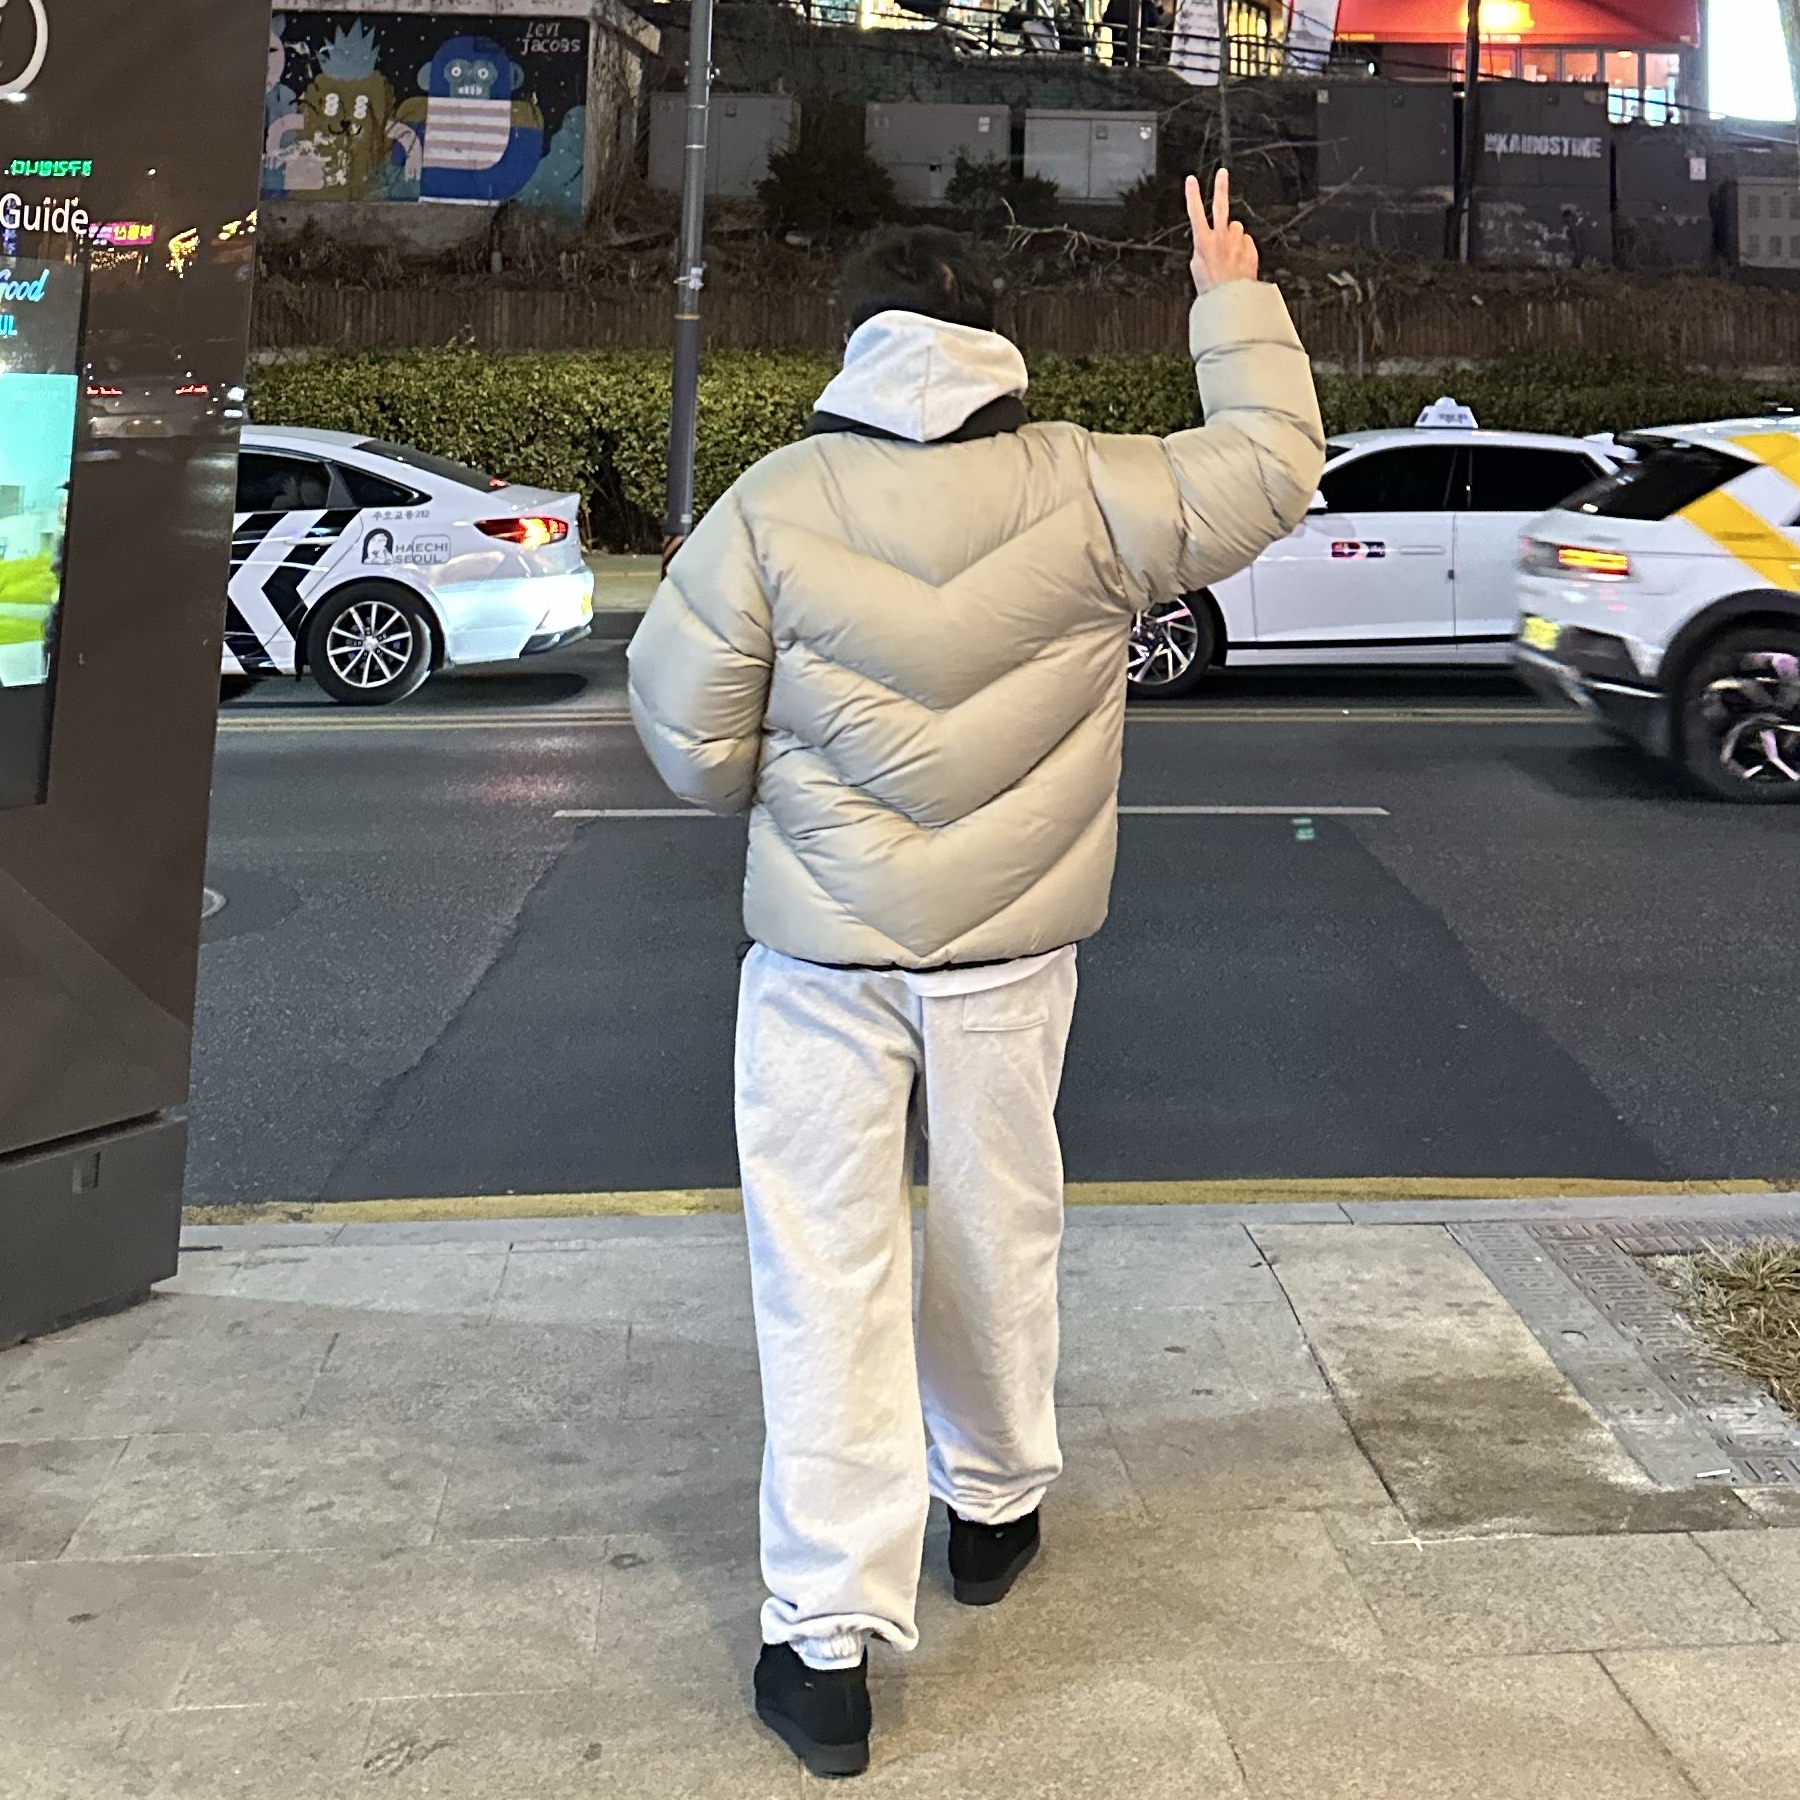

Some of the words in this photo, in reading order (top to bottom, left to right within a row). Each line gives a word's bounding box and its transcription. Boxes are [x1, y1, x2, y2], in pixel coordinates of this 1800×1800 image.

[0, 193, 89, 234] Guide
[395, 542, 449, 553] HAECHI
[395, 553, 443, 564] SEOUL
